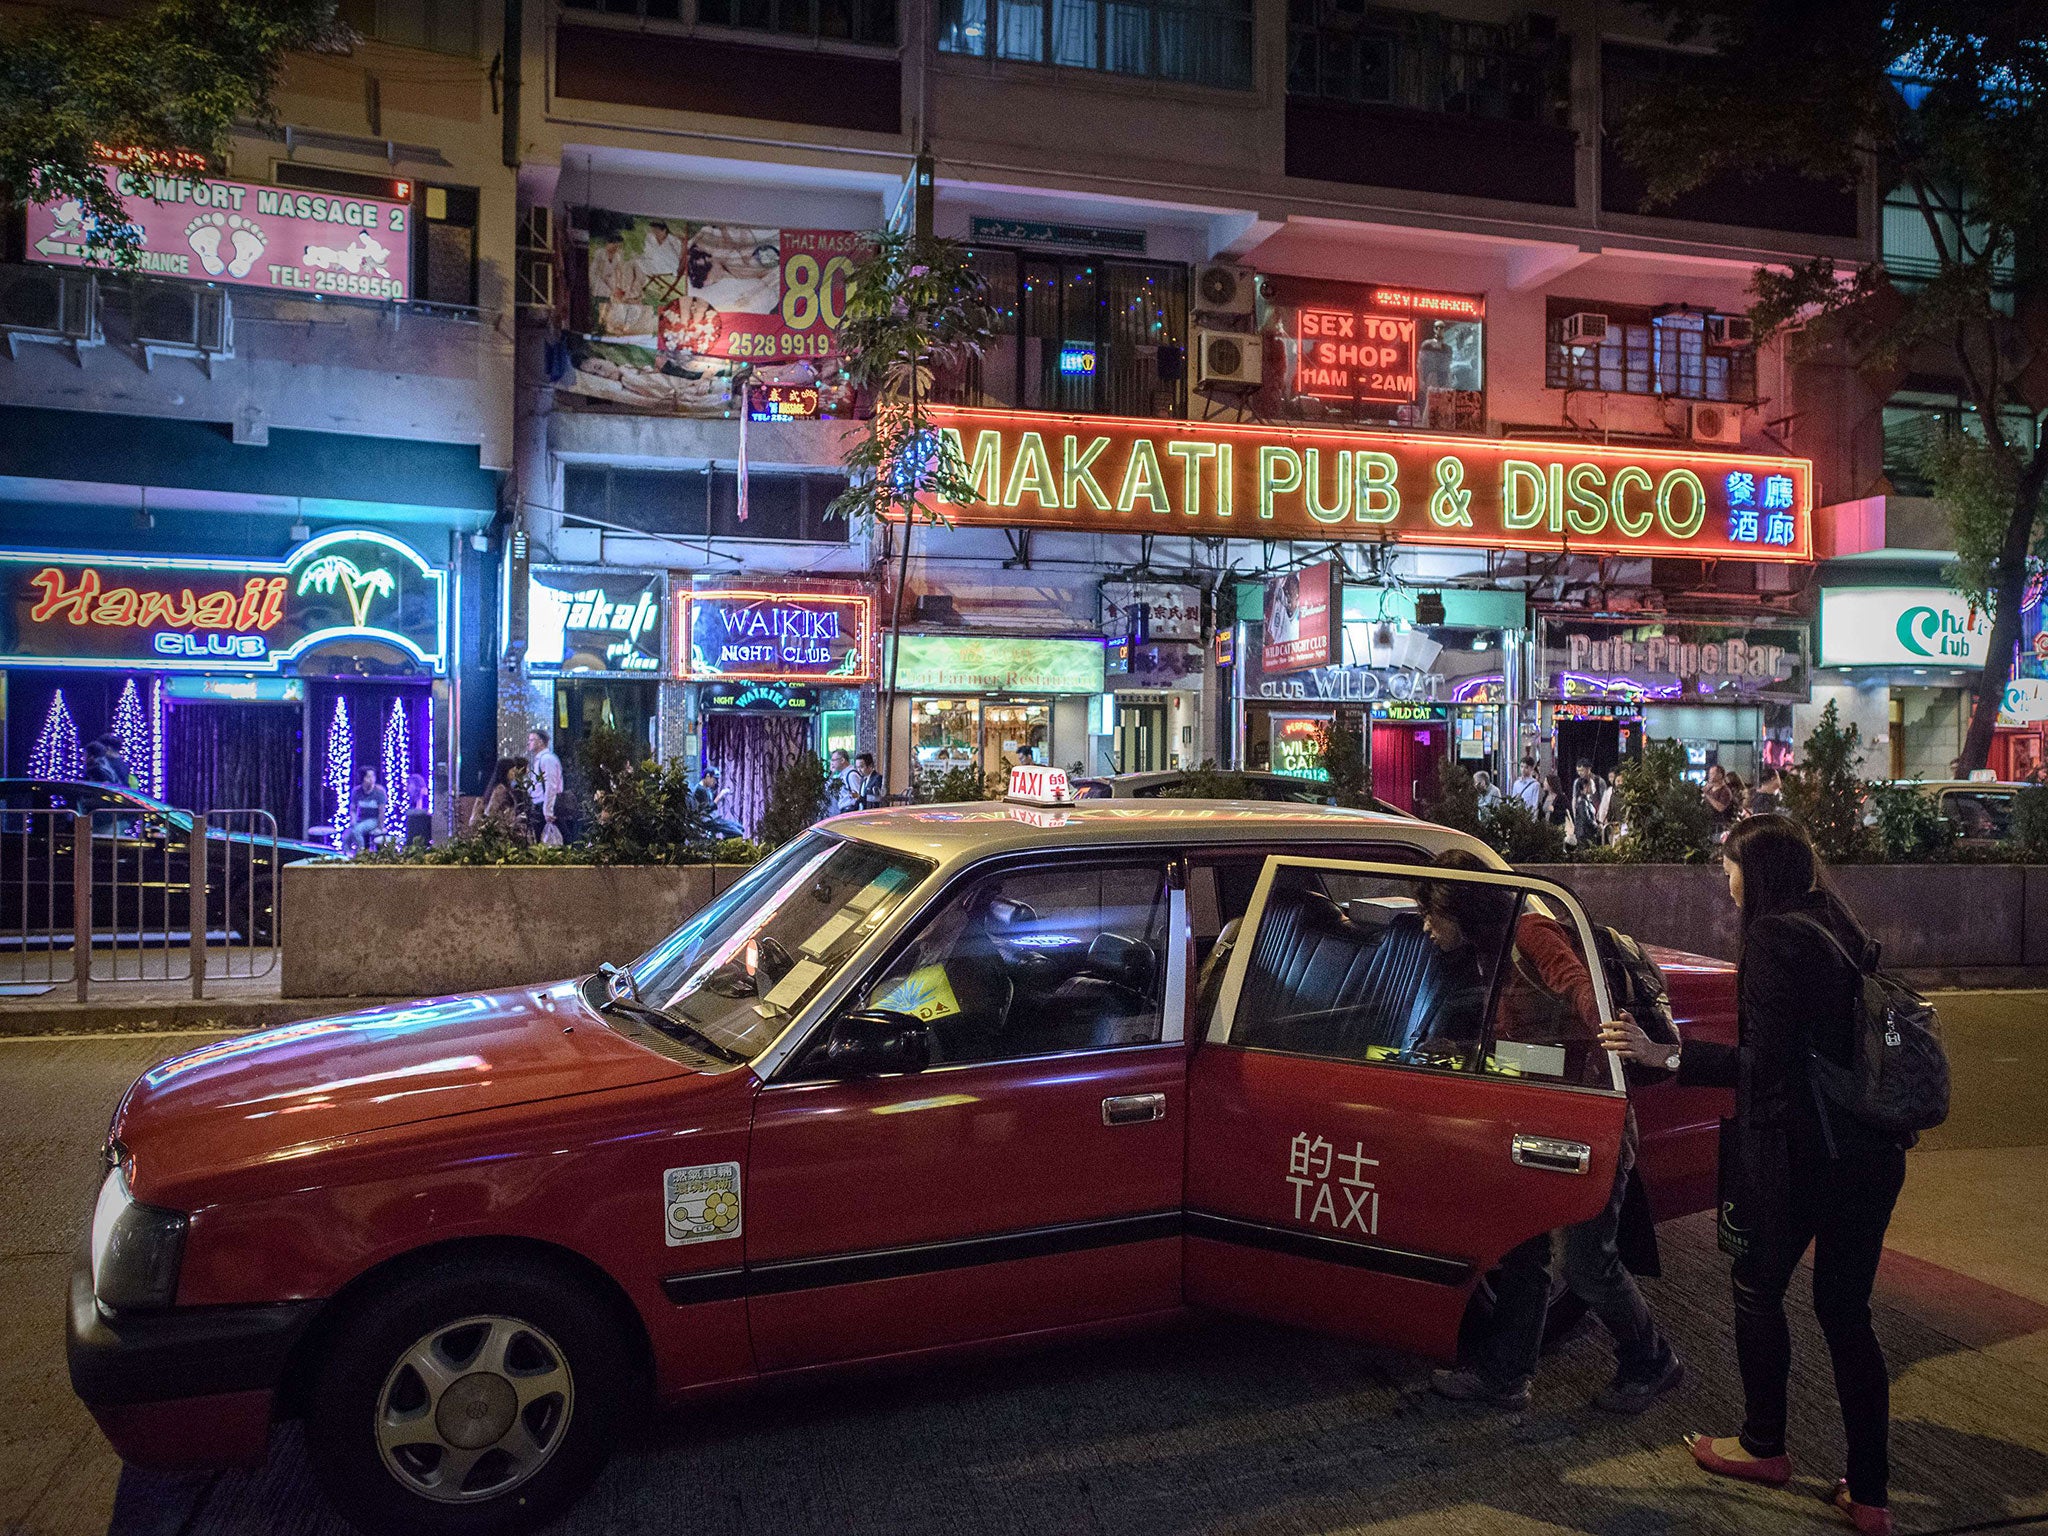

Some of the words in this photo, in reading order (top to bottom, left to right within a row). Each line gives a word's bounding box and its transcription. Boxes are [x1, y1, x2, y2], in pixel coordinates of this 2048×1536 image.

[257, 190, 378, 228] MASSAGE
[389, 209, 404, 231] 2
[783, 233, 815, 250] THAI
[268, 265, 310, 288] TEL:
[314, 271, 404, 299] 25959550
[1303, 314, 1353, 338] SEX
[1364, 319, 1414, 342] TOY
[728, 331, 776, 356] 2528
[780, 333, 829, 355] 9919
[1320, 343, 1397, 368] SHOP
[1302, 368, 1347, 387] 11AM
[1371, 374, 1412, 393] 2AM
[938, 428, 1232, 516] MAKATI
[1259, 446, 1400, 523] PUB
[1430, 455, 1473, 528] &
[1503, 459, 1706, 539] DISCO
[31, 567, 288, 632] Hawaii
[720, 607, 840, 639] WAIKIKI
[154, 631, 267, 658] CLUB
[721, 645, 773, 663] NIGHT
[783, 645, 831, 664] CLUB
[1724, 638, 1785, 677] Bar
[939, 670, 1000, 686] Farmer
[1260, 681, 1305, 699] CLUB
[1309, 668, 1379, 700] WILD
[1388, 671, 1446, 701] CAT
[713, 696, 734, 705] NIGHT
[735, 687, 787, 709] WAIKIKI
[788, 698, 806, 707] CLUB
[1388, 707, 1413, 719] WILD
[1413, 707, 1432, 719] CAT
[1281, 740, 1318, 755] WILD
[1012, 771, 1043, 797] TAXI
[1290, 1131, 1380, 1189] 的士
[1285, 1176, 1379, 1235] TAXI
